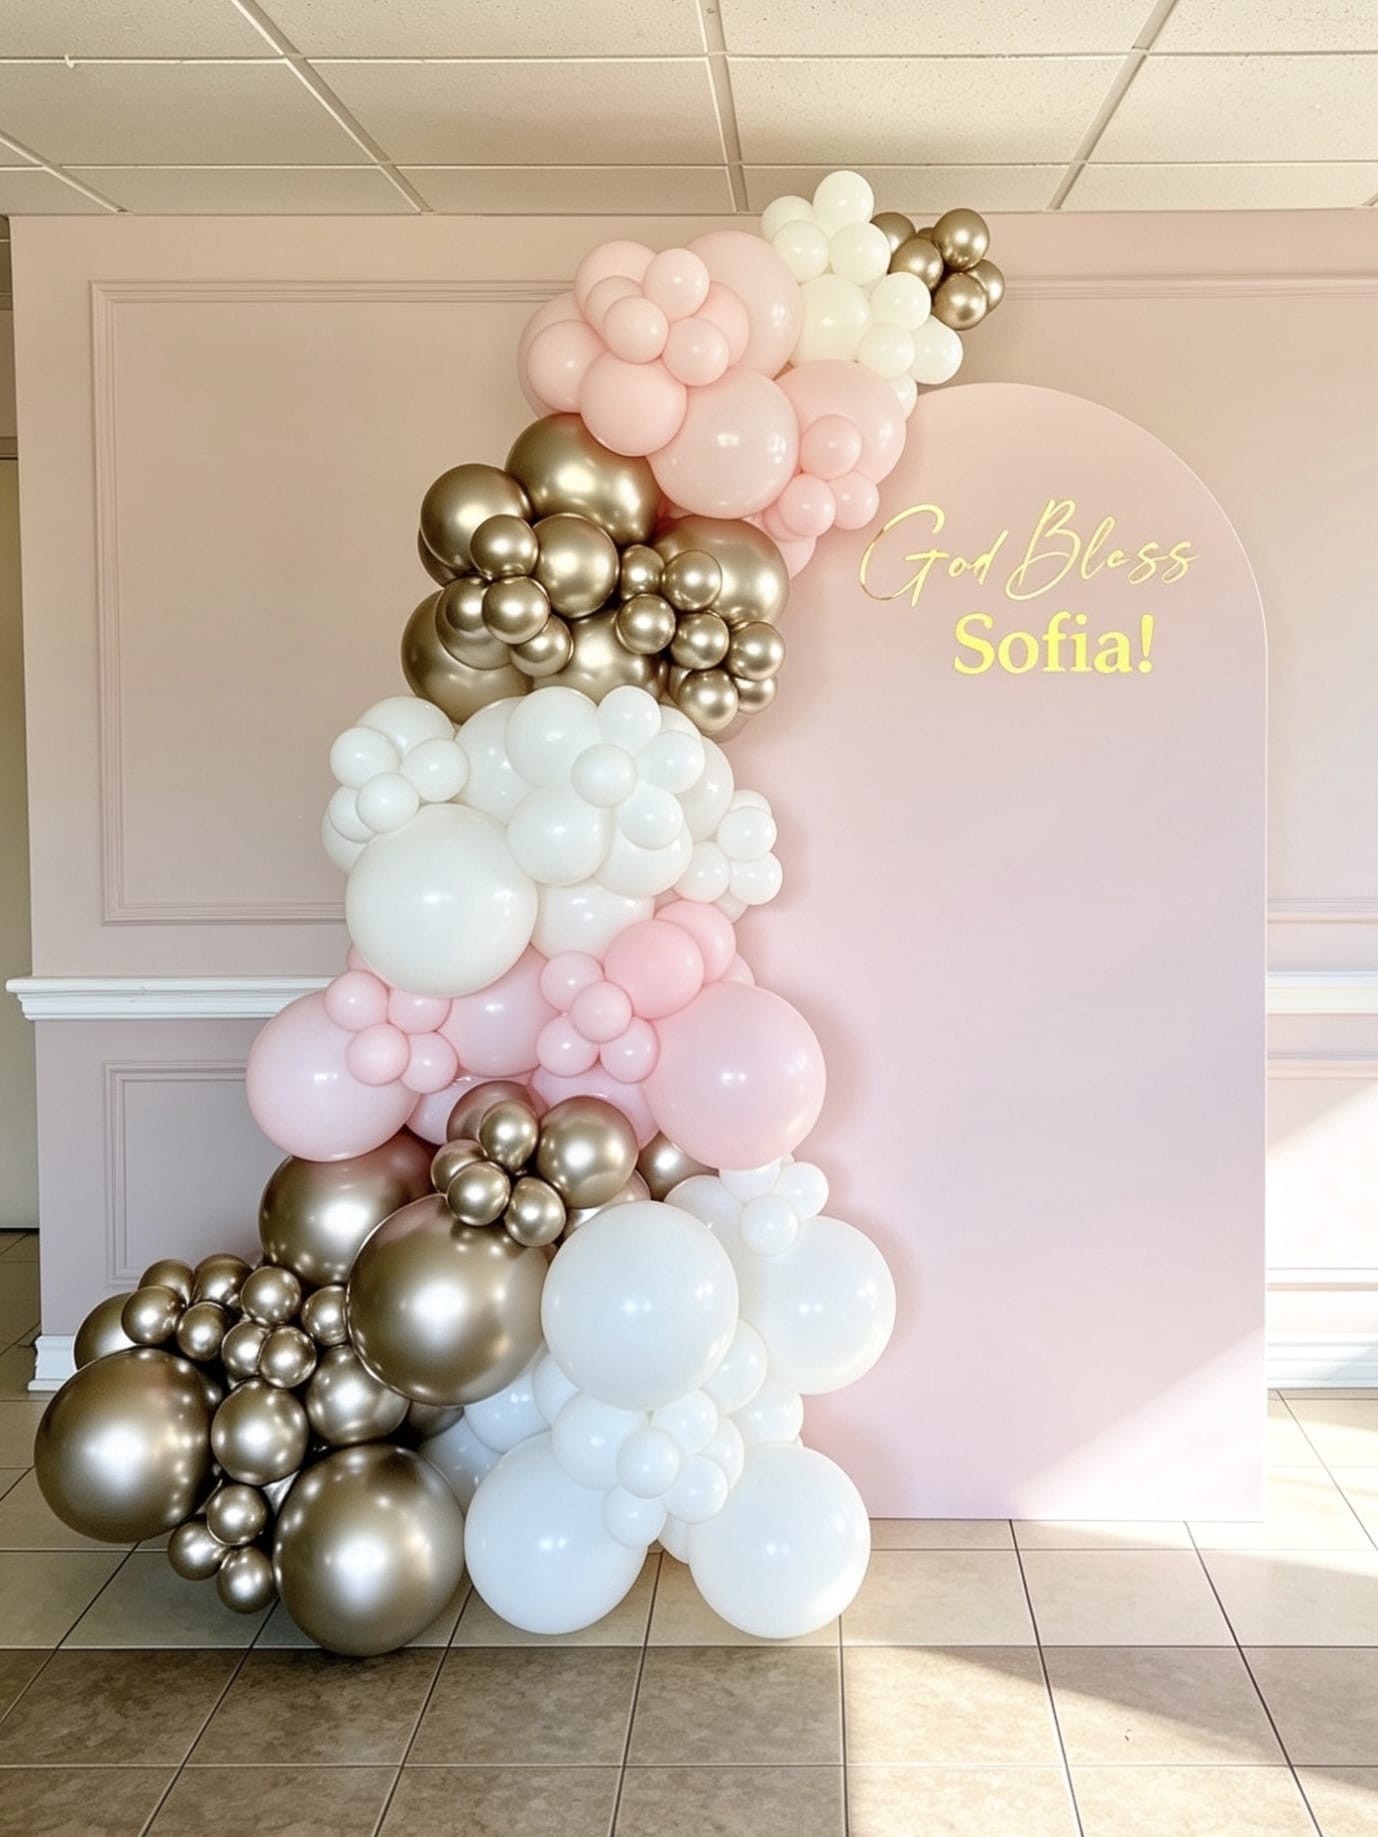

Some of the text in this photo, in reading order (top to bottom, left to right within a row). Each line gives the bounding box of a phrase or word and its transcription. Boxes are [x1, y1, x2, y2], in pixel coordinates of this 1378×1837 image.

[859, 499, 1200, 608] God Bless
[953, 610, 1155, 675] Sofia!
